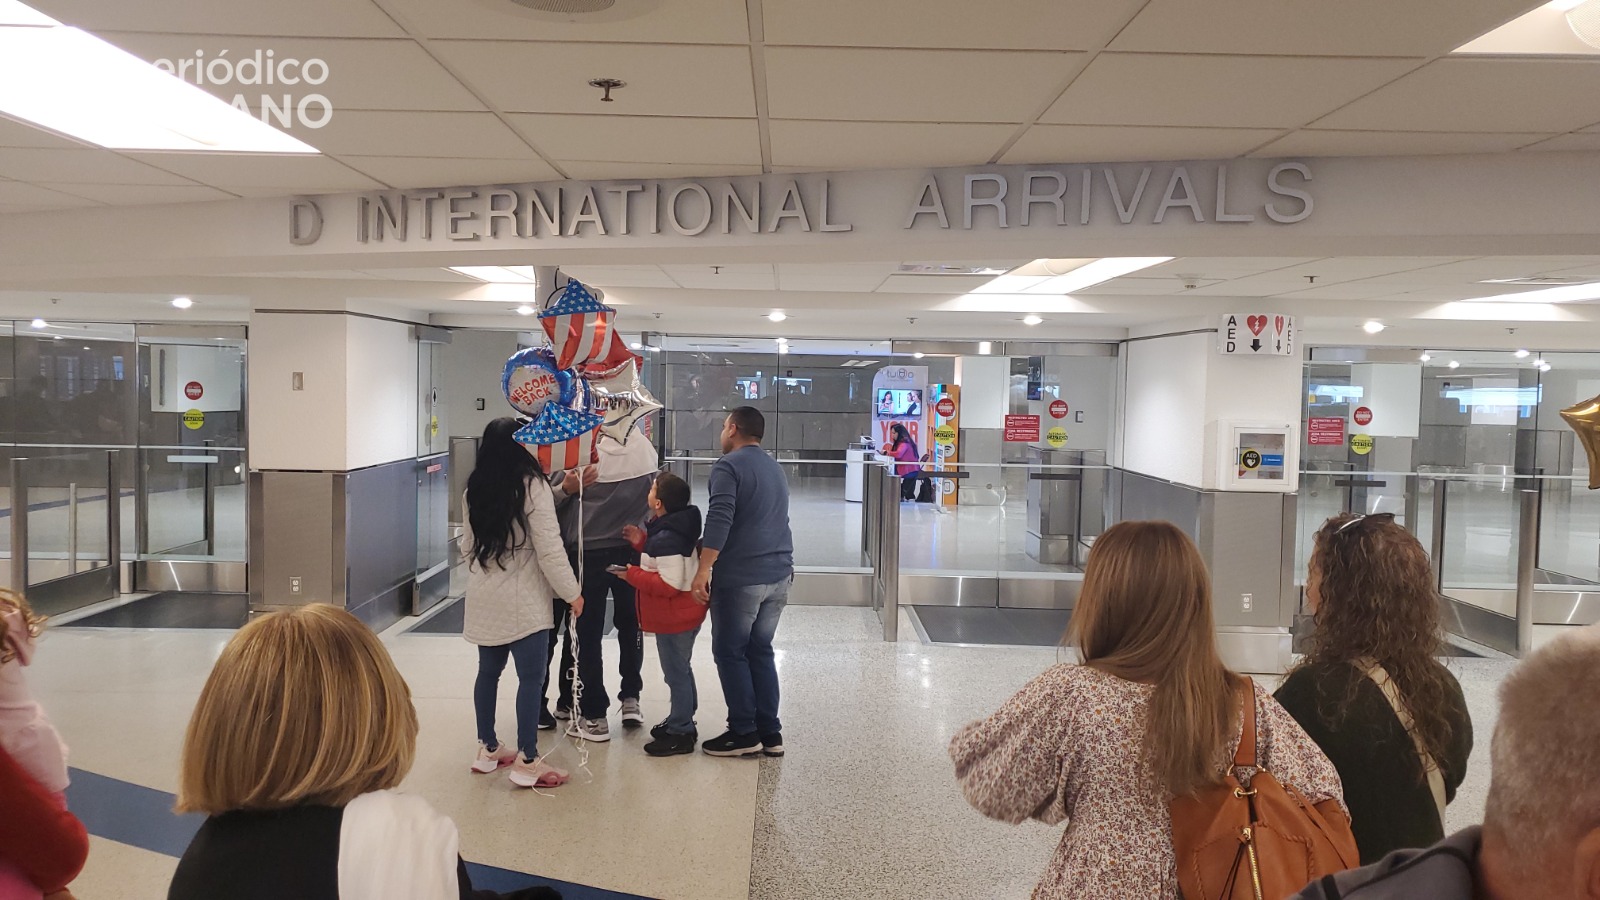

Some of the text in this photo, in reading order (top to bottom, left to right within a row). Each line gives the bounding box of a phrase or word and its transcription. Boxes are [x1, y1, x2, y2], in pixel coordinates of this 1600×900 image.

[288, 161, 1315, 245] D INTERNATIONAL ARRIVALS
[510, 373, 556, 404] WELCOME
[522, 386, 552, 405] BACK
